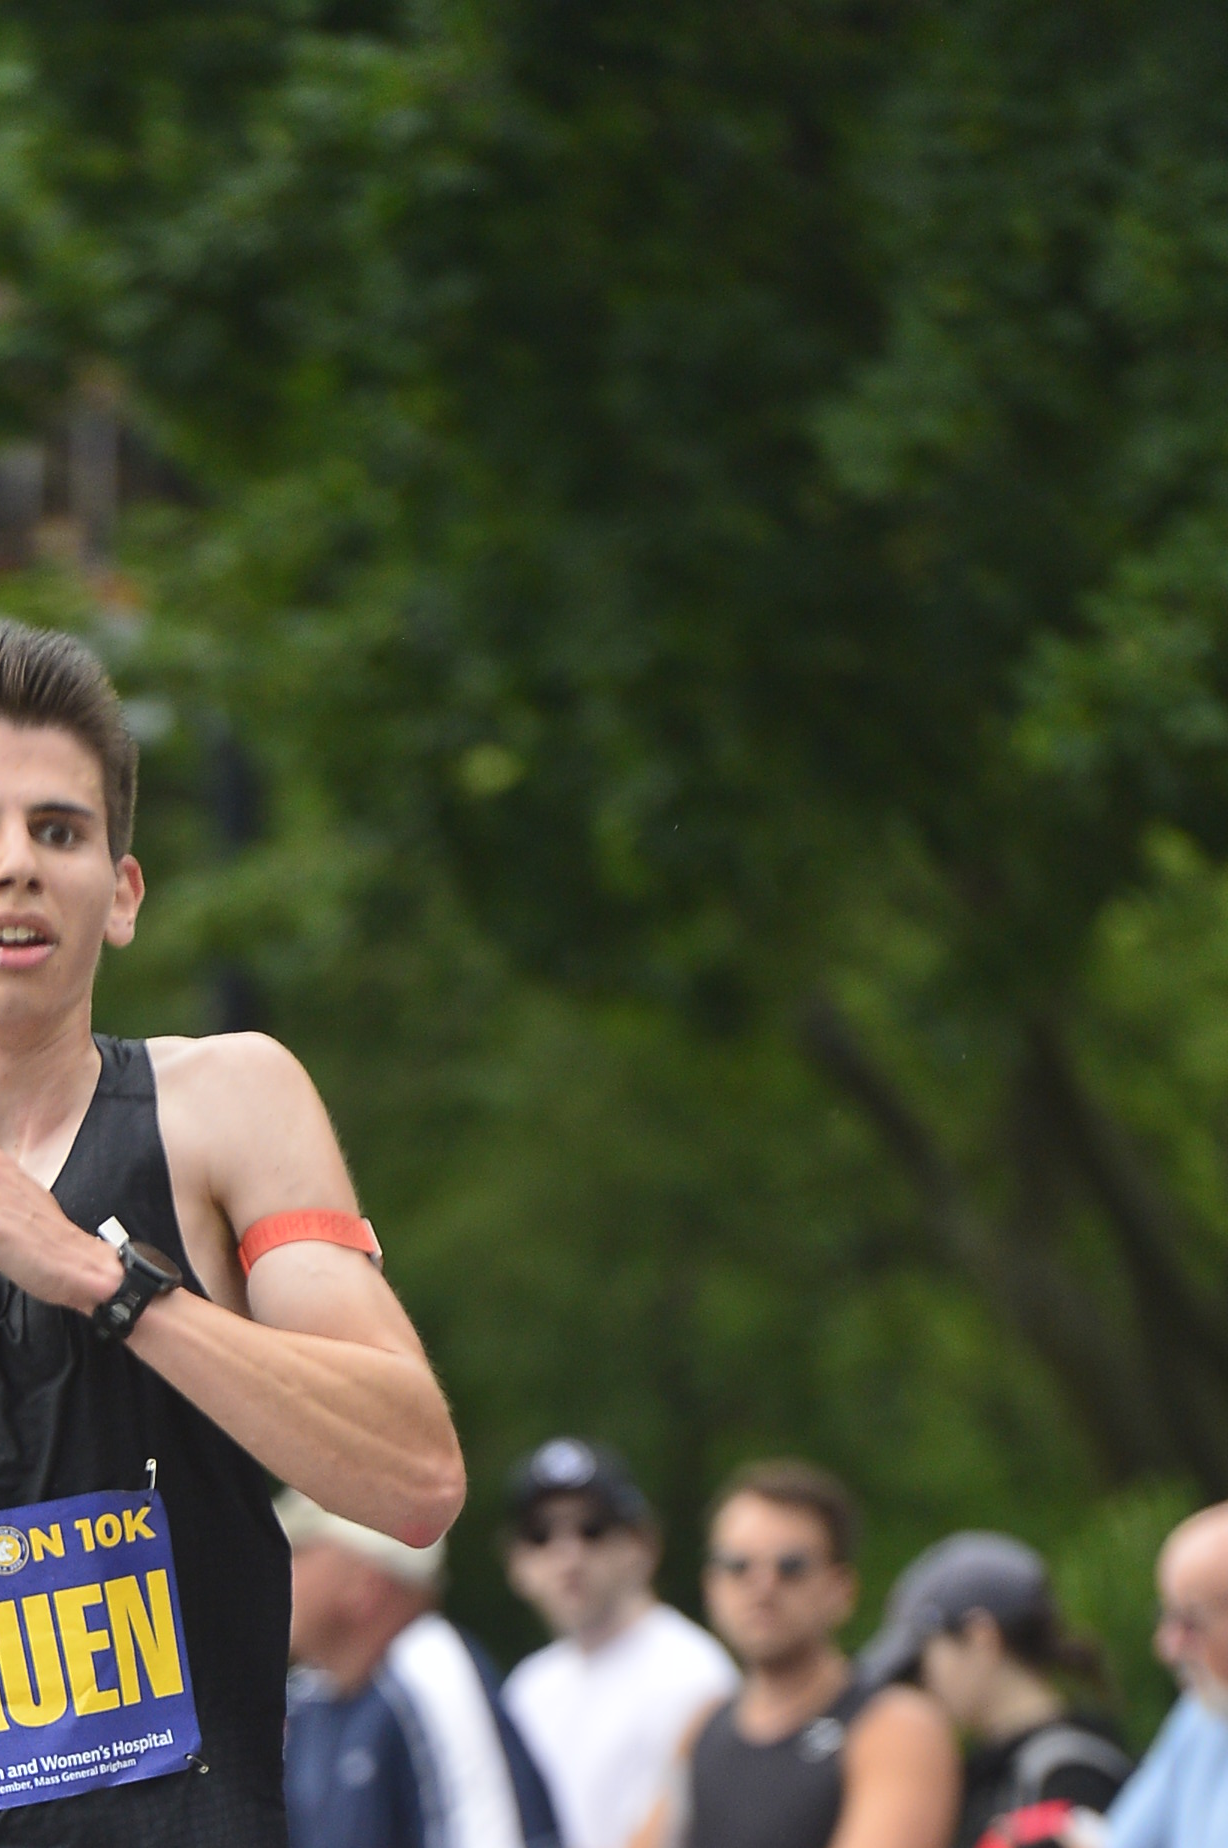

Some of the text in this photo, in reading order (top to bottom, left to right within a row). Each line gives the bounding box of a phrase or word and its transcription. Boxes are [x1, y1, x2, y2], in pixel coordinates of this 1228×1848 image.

[74, 1506, 156, 1551] 10K
[7, 1758, 38, 1780] and
[39, 1744, 110, 1772] Women's
[112, 1728, 174, 1757] Hospital
[34, 1774, 60, 1788] Mass
[61, 1764, 98, 1781] General
[99, 1757, 137, 1775] Brigham
